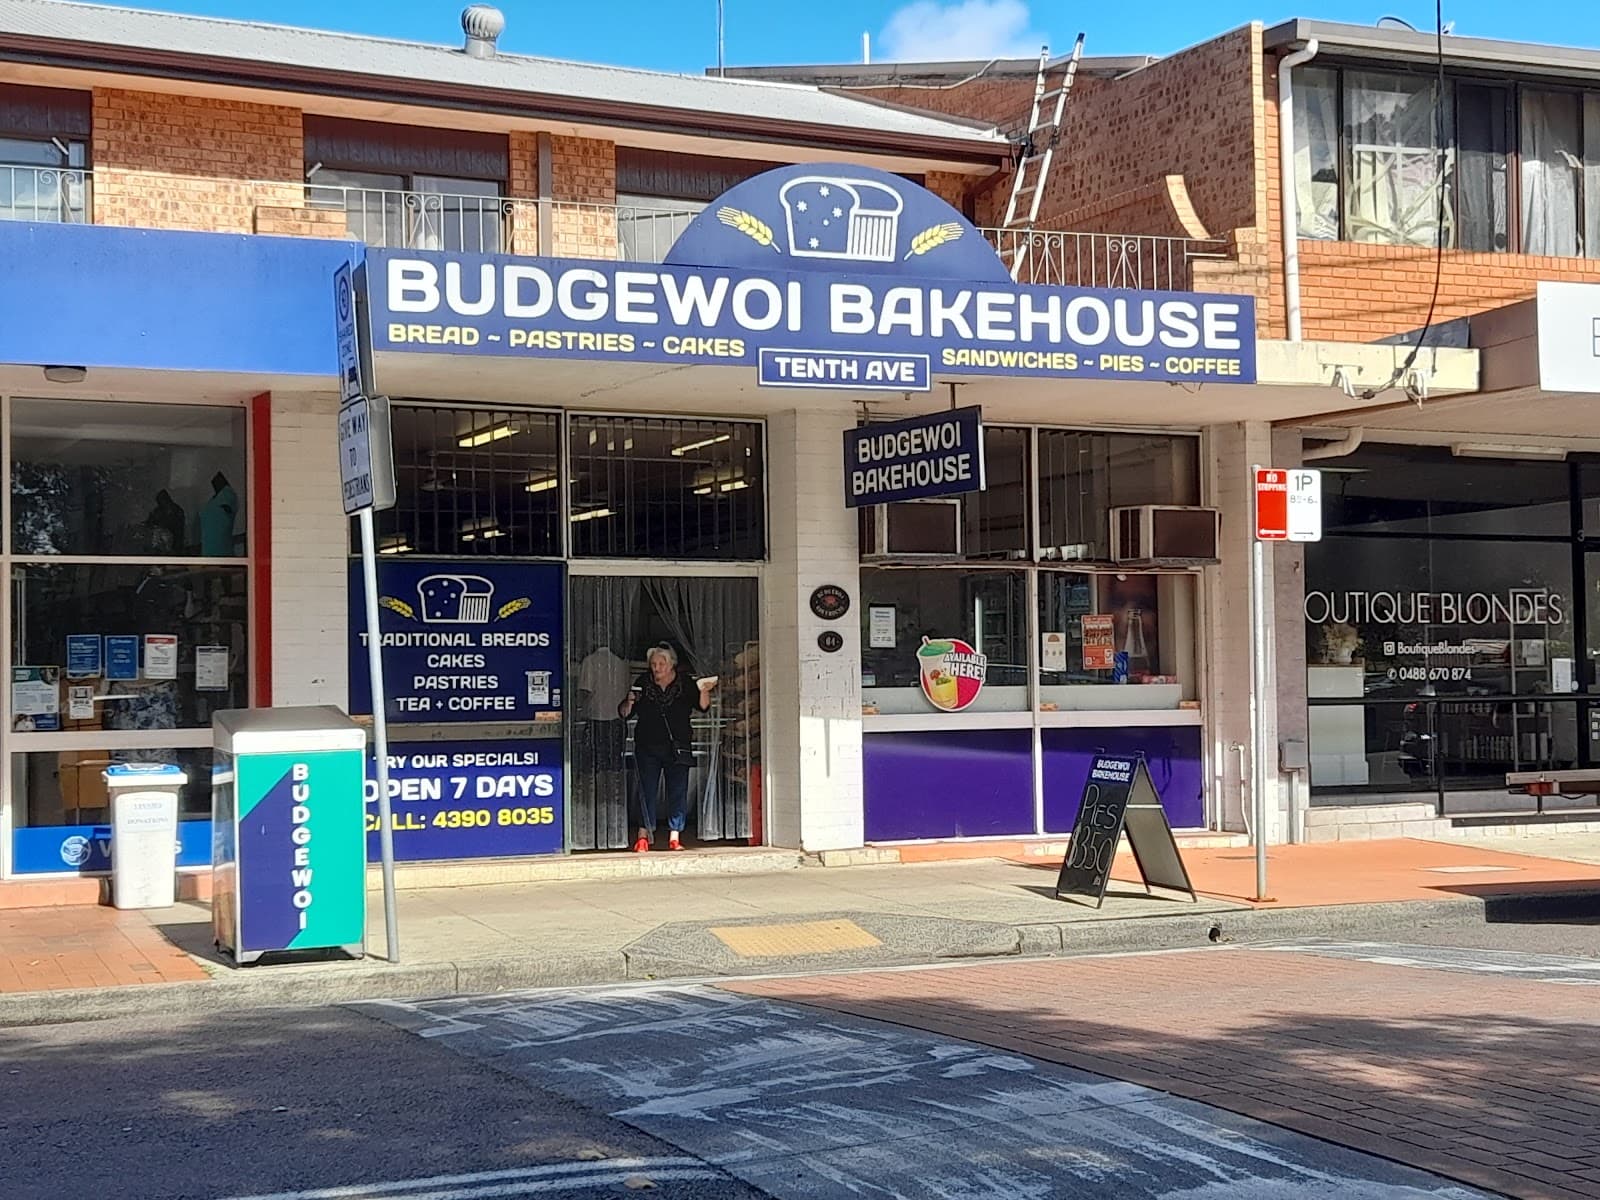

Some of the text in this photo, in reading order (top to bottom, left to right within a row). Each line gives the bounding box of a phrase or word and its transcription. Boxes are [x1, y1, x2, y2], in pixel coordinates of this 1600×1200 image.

[387, 258, 1241, 350] BUDGEWOI BAKEHOUSE
[387, 323, 480, 346] BREAD
[509, 329, 635, 353] PASTRIES
[662, 336, 745, 357] CAKES
[774, 357, 916, 382] TENTH AVE
[942, 348, 1078, 370] SANDWICHES
[1099, 355, 1144, 372] PIES
[1165, 357, 1241, 376] COFFEE
[858, 421, 961, 463] BUDGEWOI
[852, 453, 972, 496] BAKEHOUSE
[1294, 473, 1313, 491] 1P
[1304, 591, 1563, 625] OUTIQUE BLONDES
[359, 632, 550, 647] TADITIONAL BREADS
[1397, 640, 1475, 658] BoutiqueBlondes
[427, 654, 486, 668] CAKES
[1399, 667, 1472, 680] 0488 670 874
[413, 675, 499, 689] PASTRIES
[396, 697, 431, 711] TEA
[448, 696, 516, 711] COFFEE
[372, 752, 539, 769] RY OUR SPECIALS!
[364, 774, 554, 803] OPEN 7 DAYS
[432, 810, 491, 828] 4390
[497, 807, 554, 826] 8035
[1081, 784, 1119, 830] PIES
[291, 763, 313, 930] BUDGEWOI
